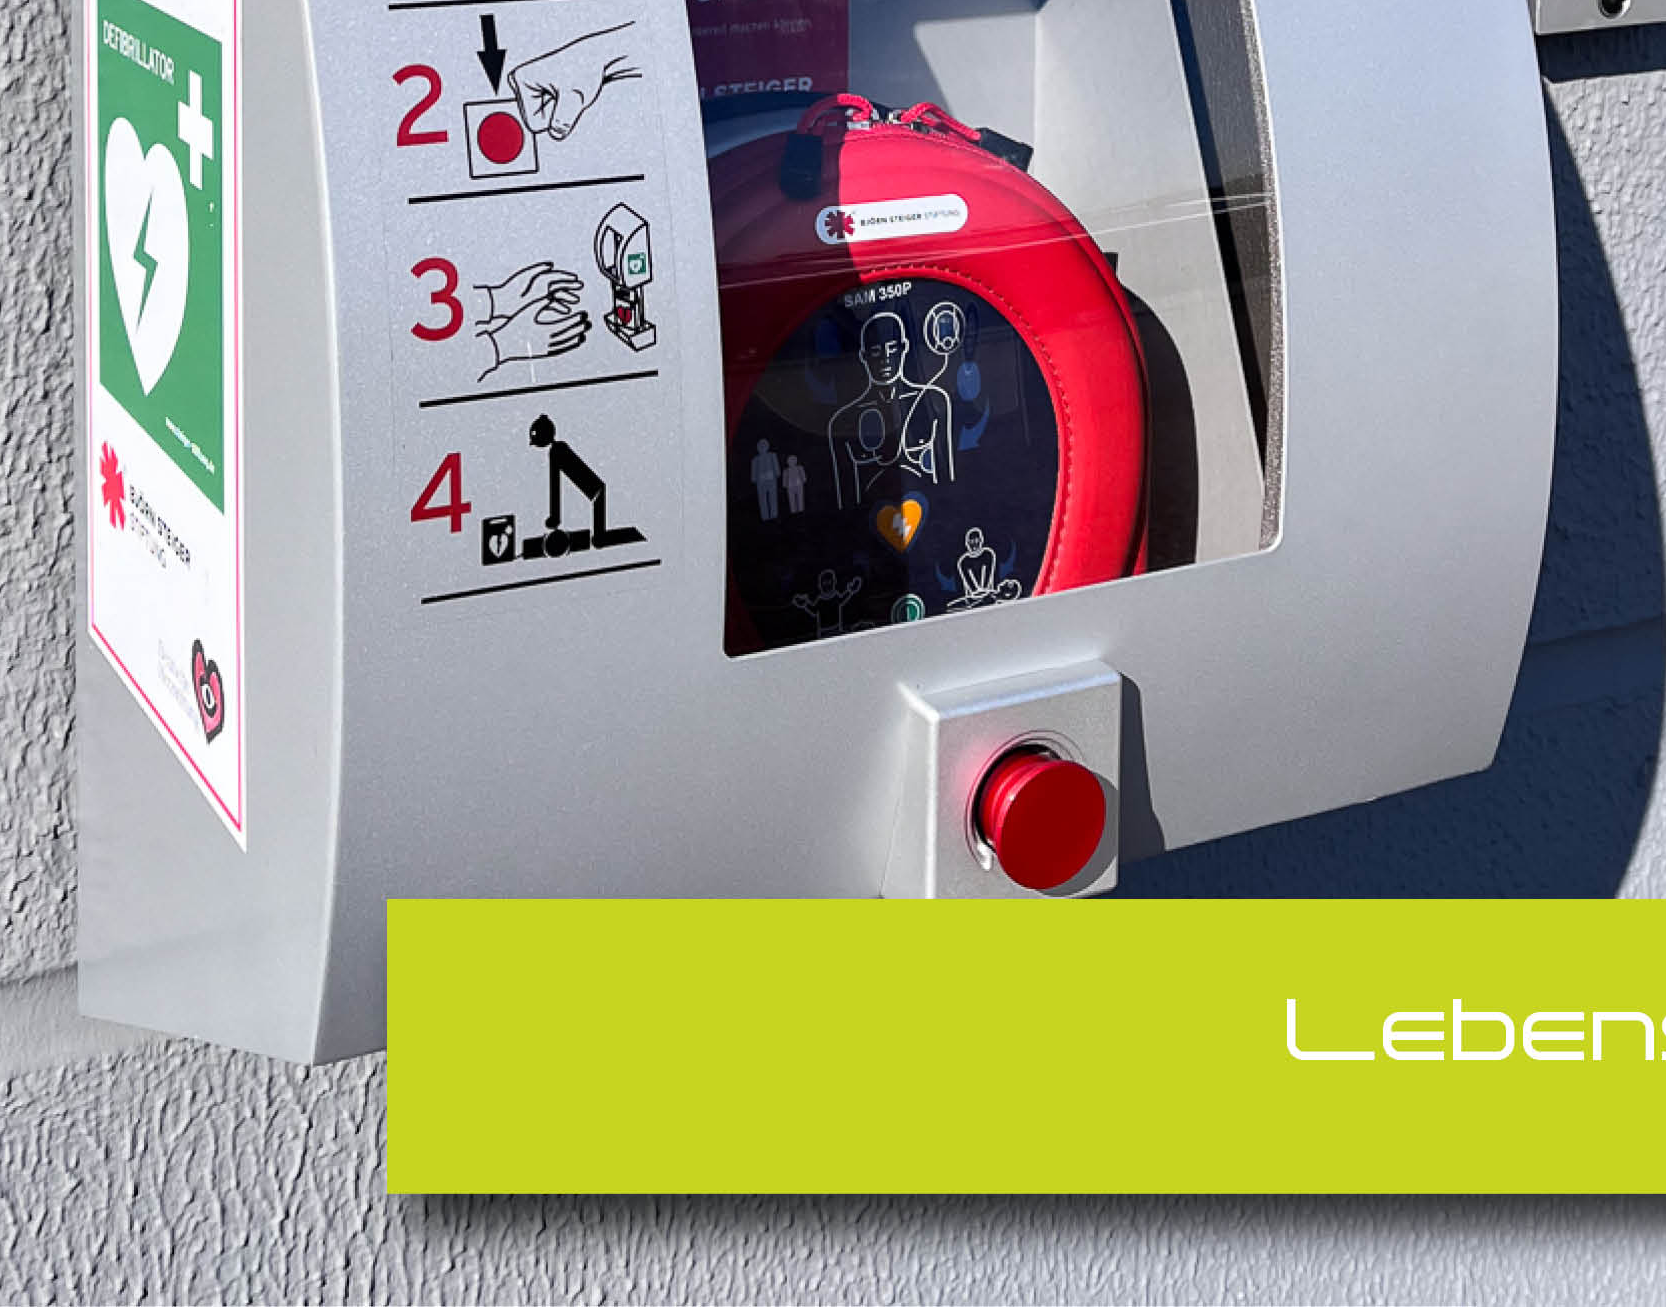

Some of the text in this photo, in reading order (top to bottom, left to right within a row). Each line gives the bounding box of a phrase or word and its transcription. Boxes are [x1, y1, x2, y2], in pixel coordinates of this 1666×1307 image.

[103, 20, 175, 85] DEFIBRILLATOR
[392, 64, 449, 147] 2
[410, 256, 464, 341] 3
[879, 281, 912, 301] 350P
[410, 452, 472, 534] 4
